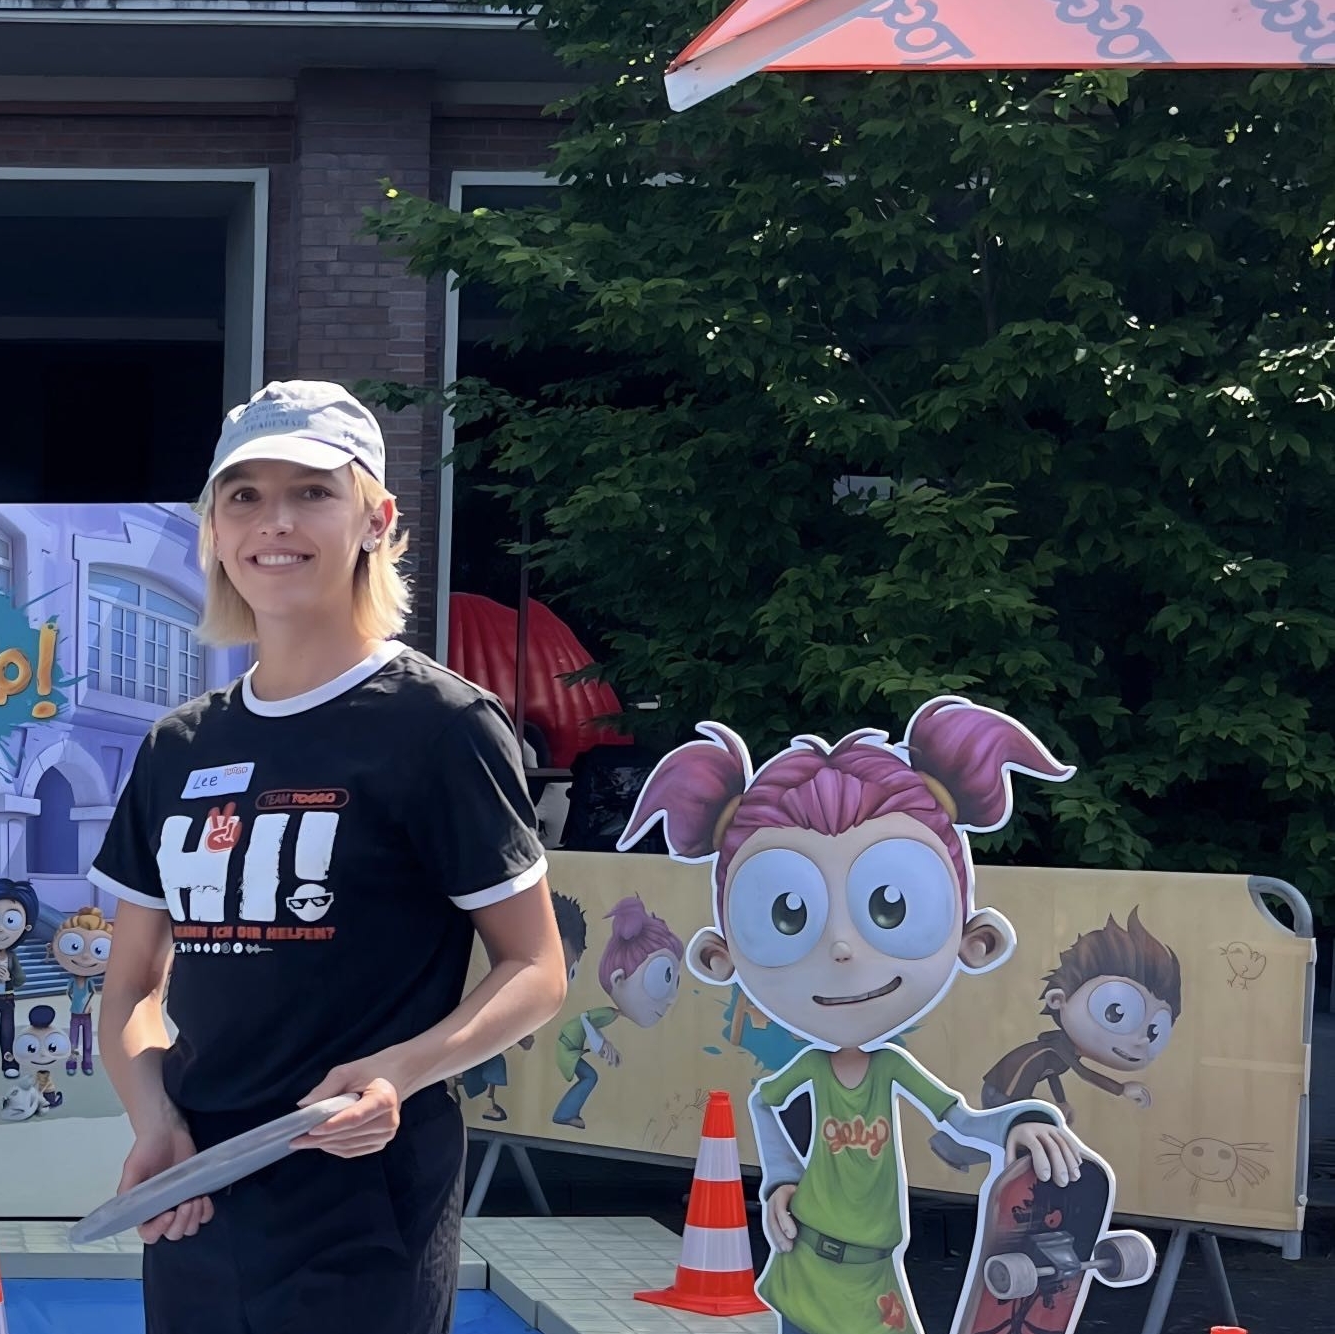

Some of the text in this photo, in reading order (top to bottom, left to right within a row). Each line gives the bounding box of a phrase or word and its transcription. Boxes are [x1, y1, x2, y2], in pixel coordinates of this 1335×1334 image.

[192, 775, 218, 790] Lee
[156, 811, 339, 923] HI!
[212, 925, 233, 939] ICH
[237, 925, 262, 940] DIR
[266, 926, 336, 940] HELFEN?
